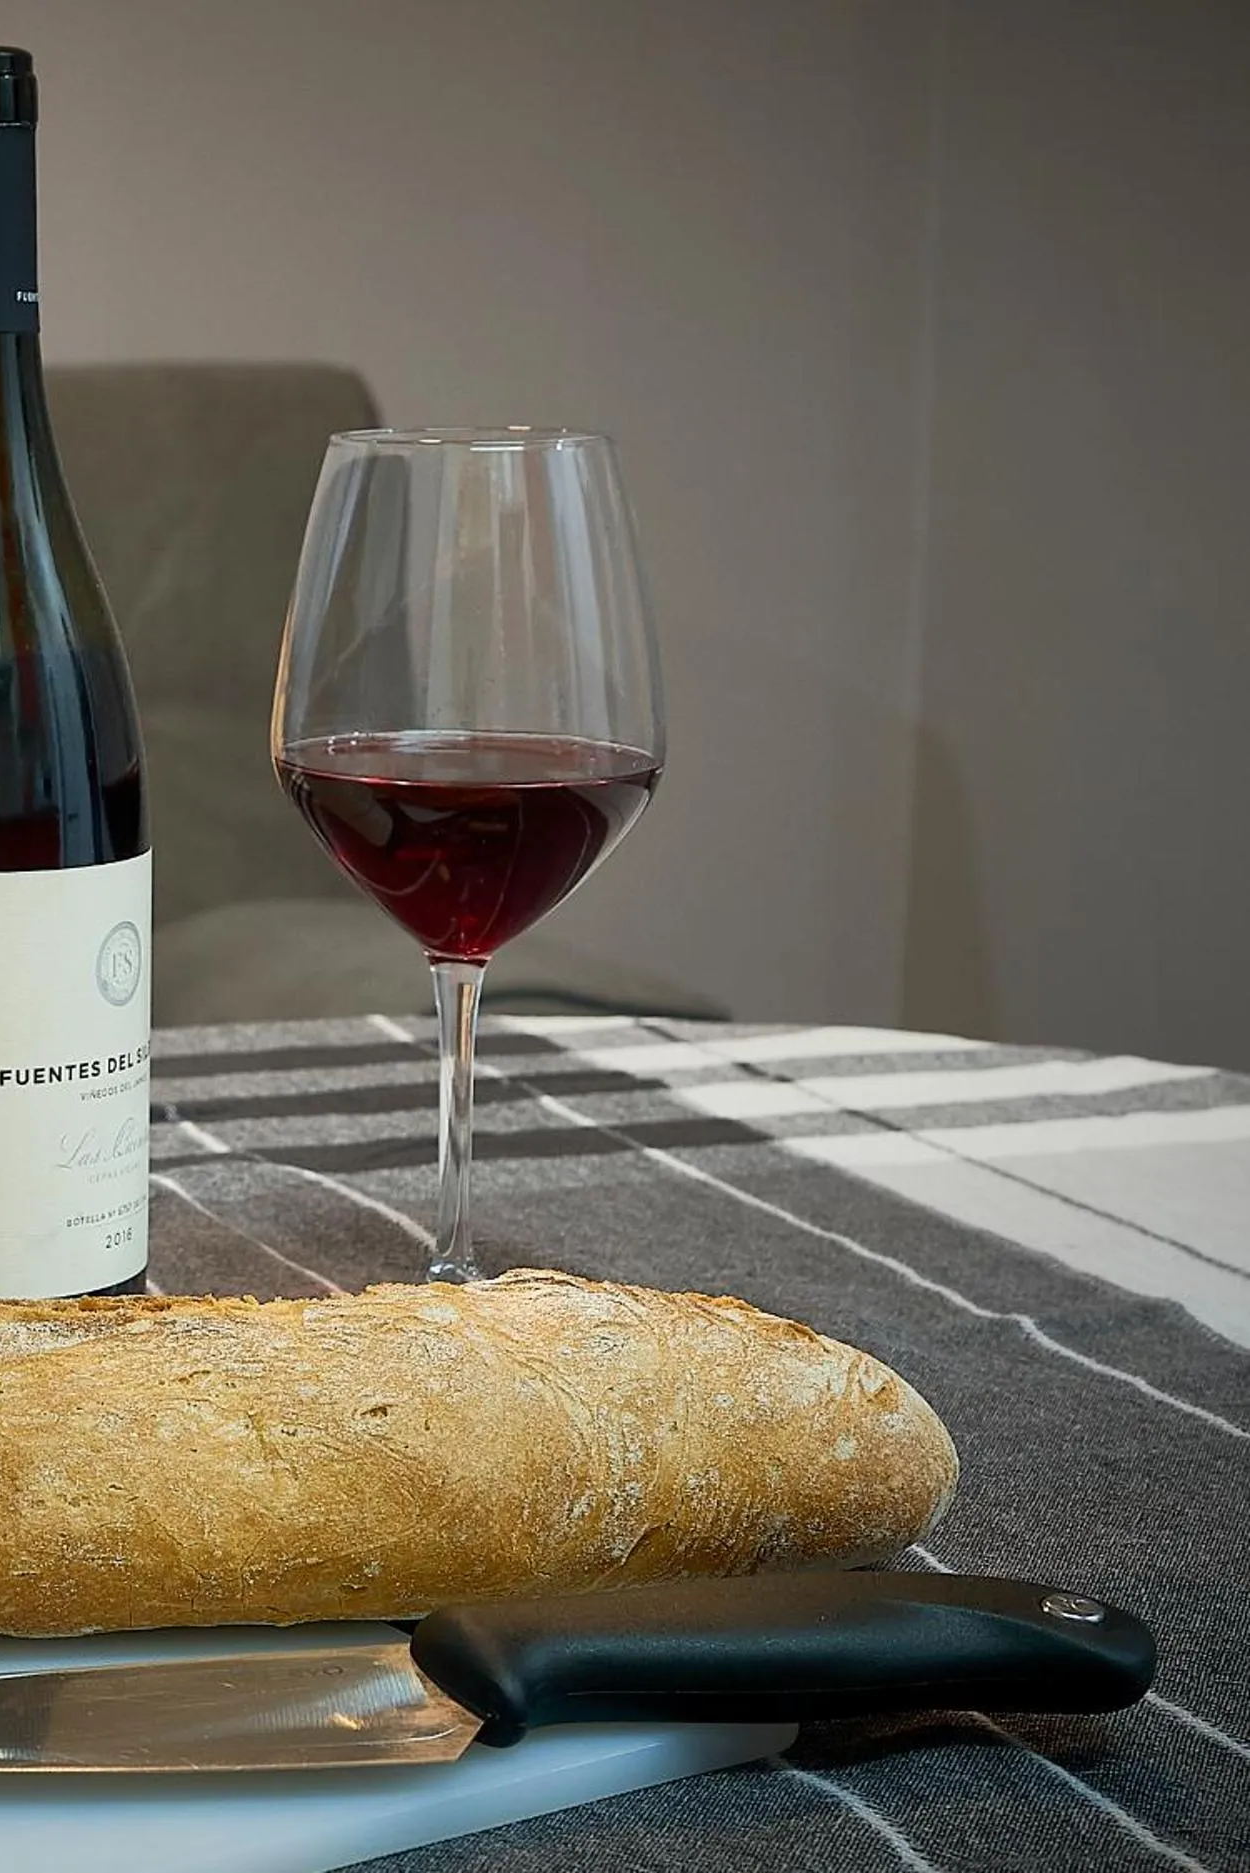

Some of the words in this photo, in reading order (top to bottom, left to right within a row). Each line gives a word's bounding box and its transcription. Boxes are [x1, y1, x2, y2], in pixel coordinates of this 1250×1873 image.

[0, 1060, 101, 1087] FUENTES
[107, 1052, 134, 1075] DEL
[66, 1213, 106, 1228] BOTELLA
[105, 1227, 133, 1249] 2016
